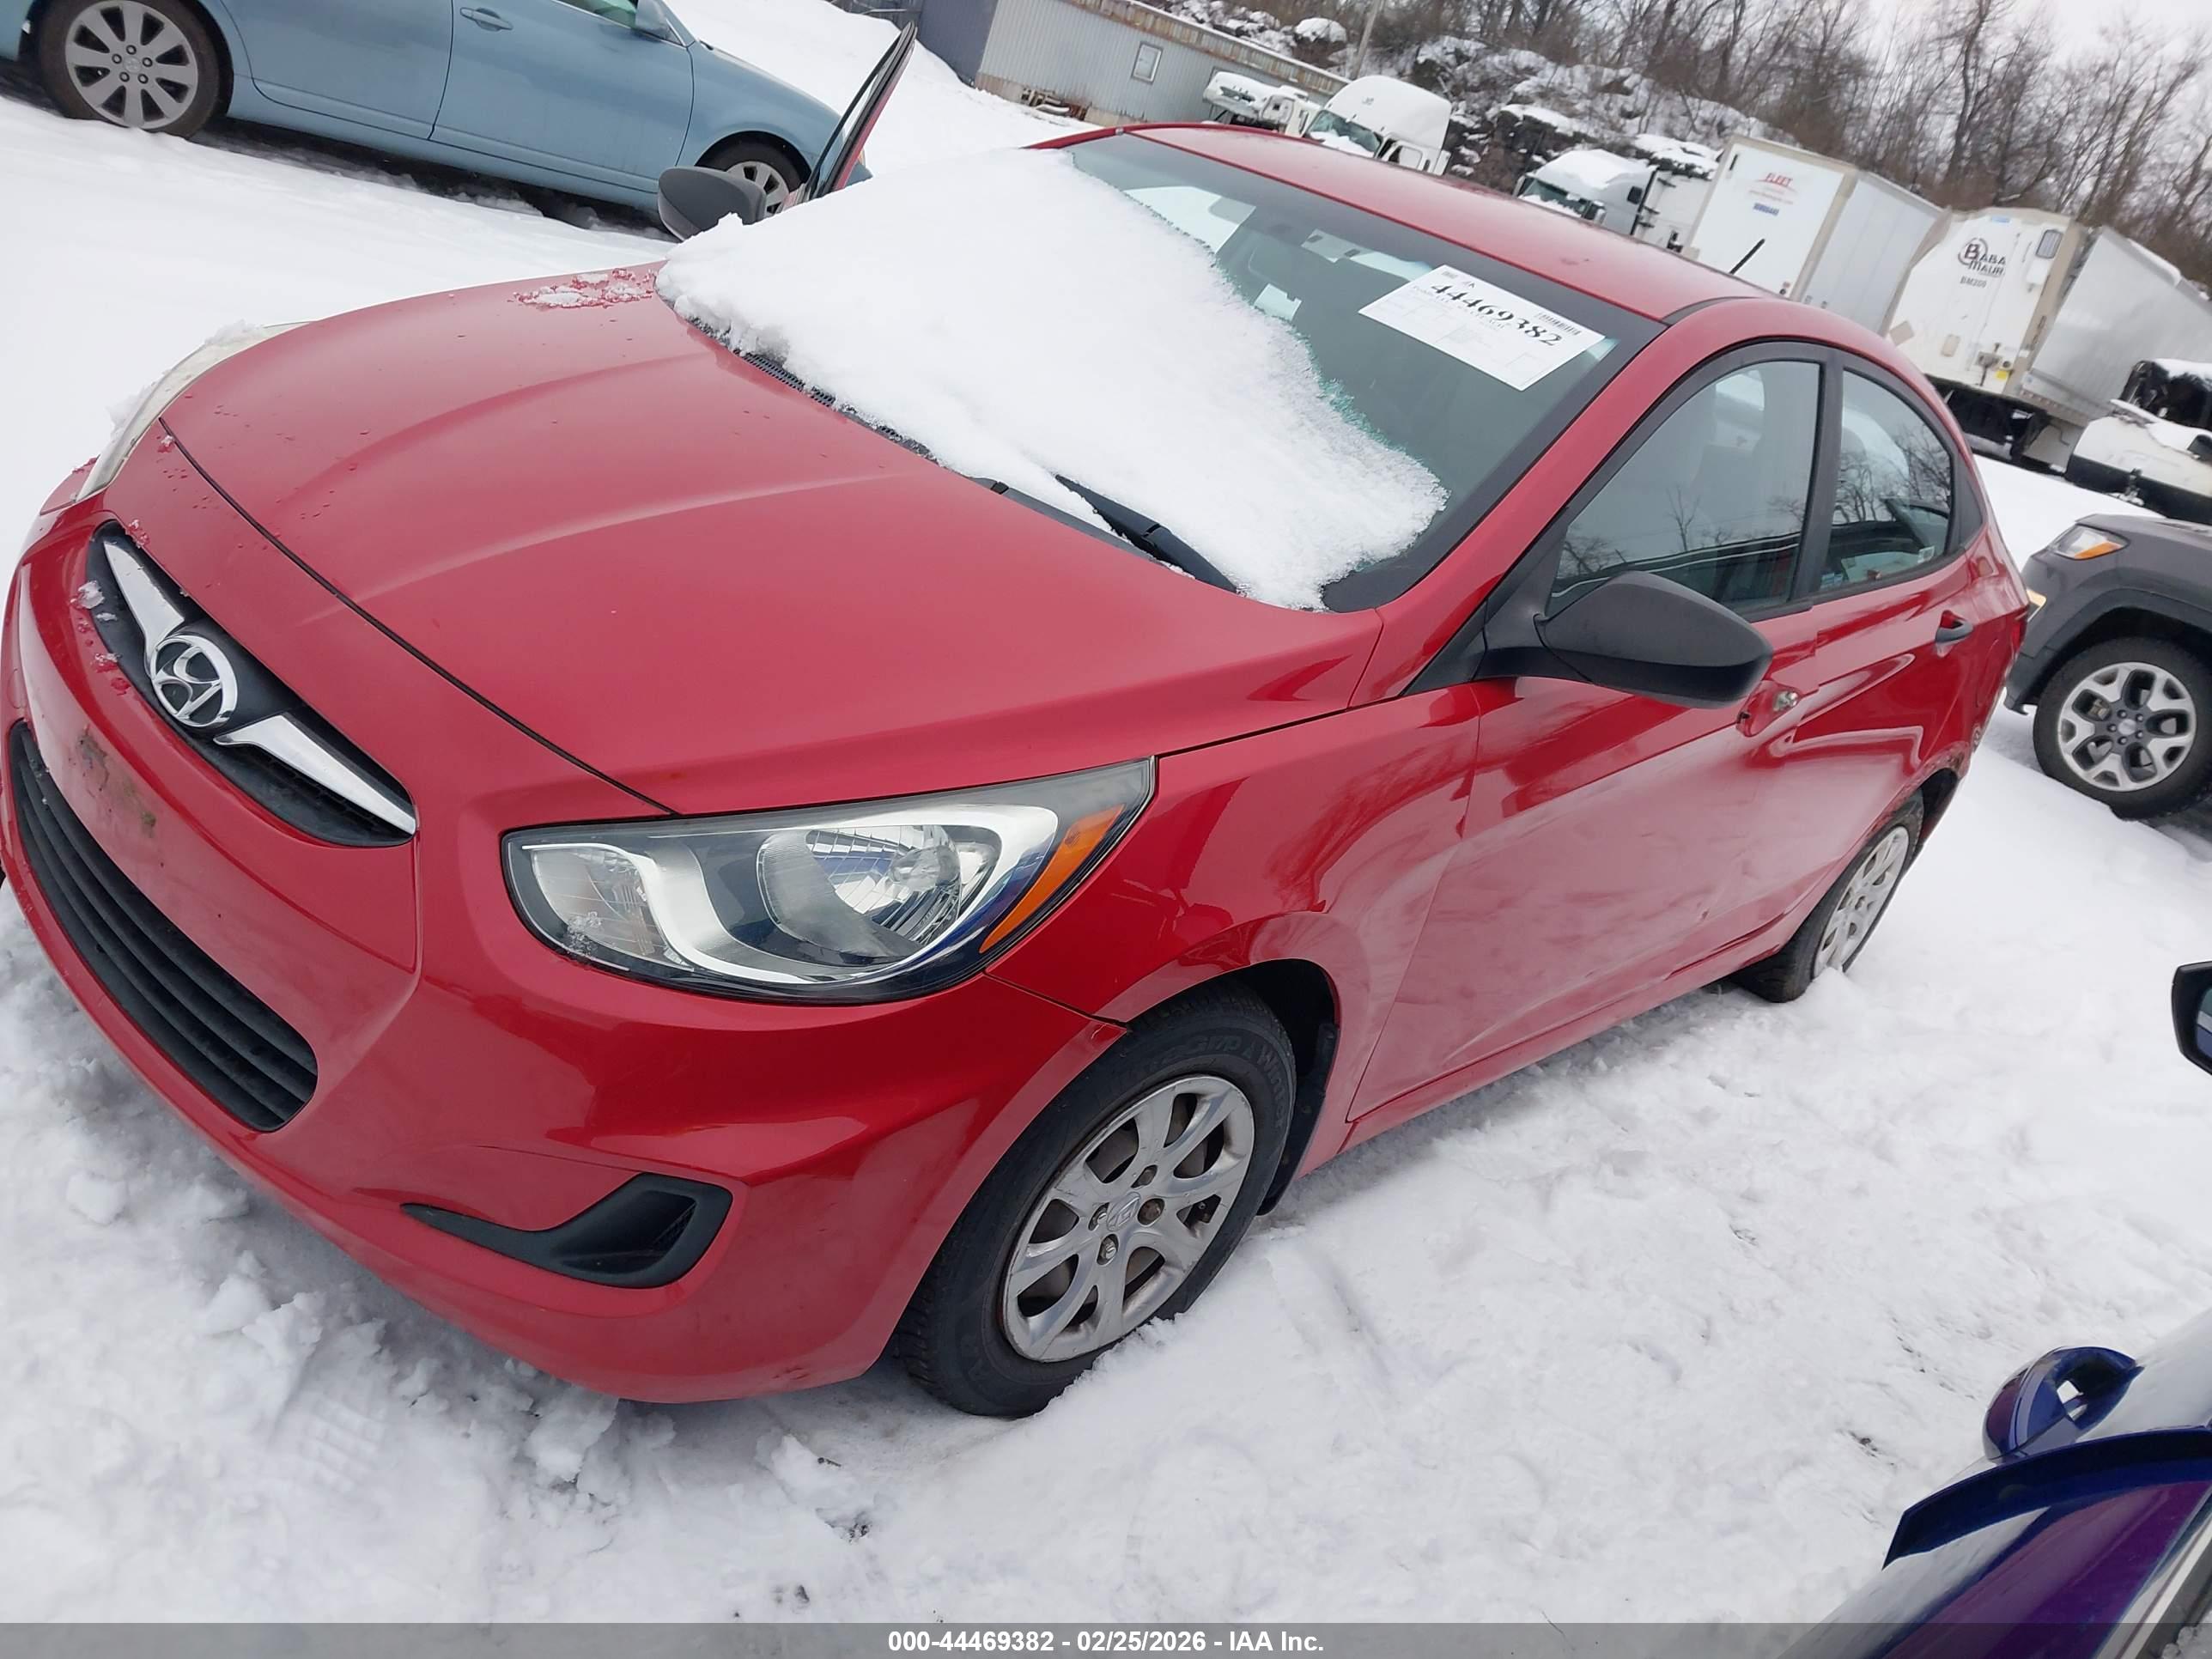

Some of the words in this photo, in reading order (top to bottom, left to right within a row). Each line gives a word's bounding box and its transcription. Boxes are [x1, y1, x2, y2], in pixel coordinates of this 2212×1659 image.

[1765, 172, 1793, 187] FLEET
[1964, 243, 2006, 264] BABA
[1431, 283, 1563, 346] 44469382
